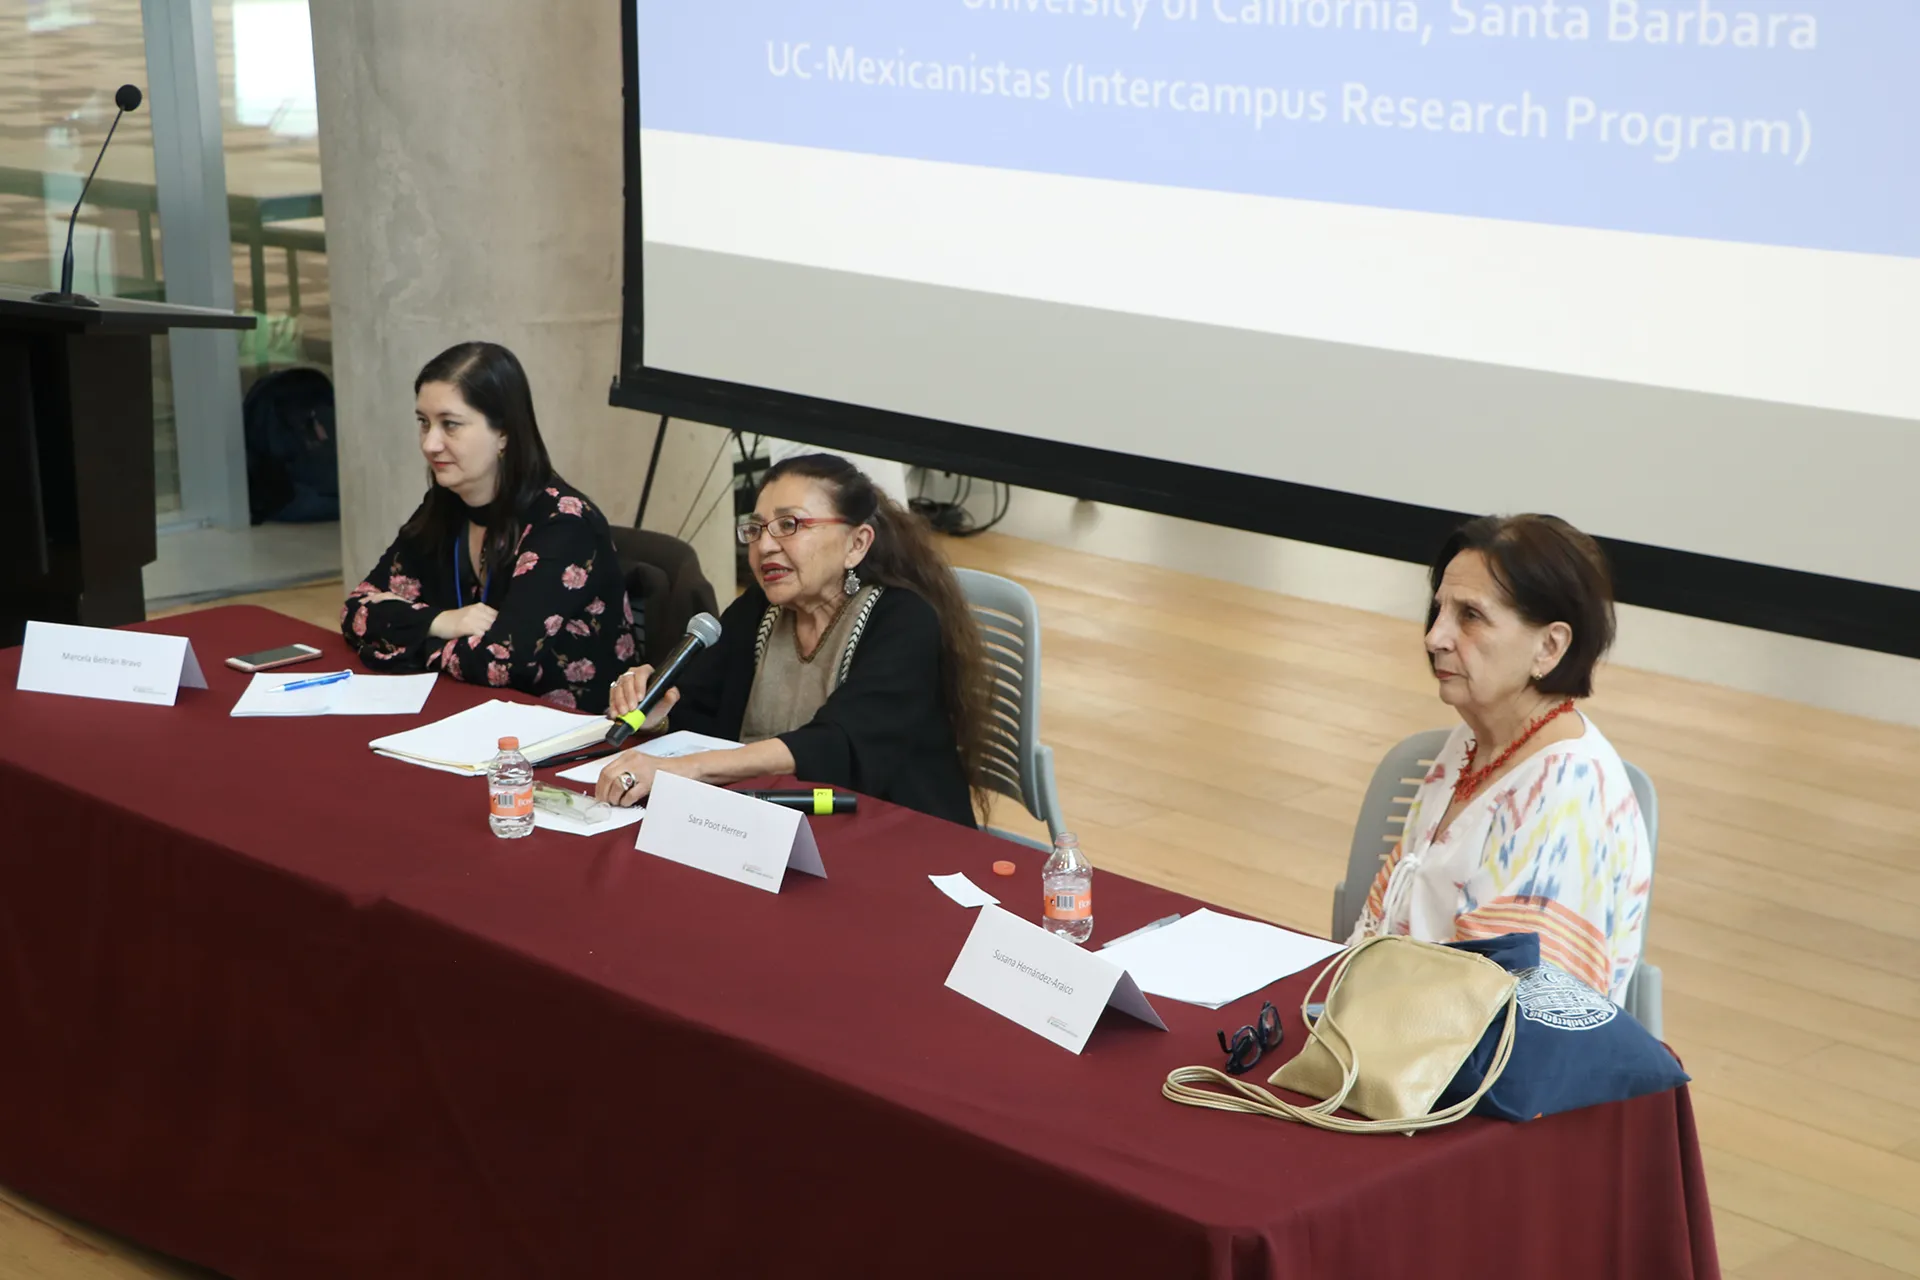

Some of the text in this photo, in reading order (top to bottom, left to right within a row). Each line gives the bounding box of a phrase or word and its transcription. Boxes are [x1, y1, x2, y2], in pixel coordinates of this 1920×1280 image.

[963, 0, 1818, 50] ersity of California, Santa Barbara
[764, 40, 1812, 166] UC-Mexicanistas (Intercampus Research Program)
[61, 652, 92, 664] Marcela
[121, 658, 142, 668] Bravo
[688, 813, 748, 839] Sara Poot Herrera
[992, 949, 1074, 996] Susana Hernández-Araico
